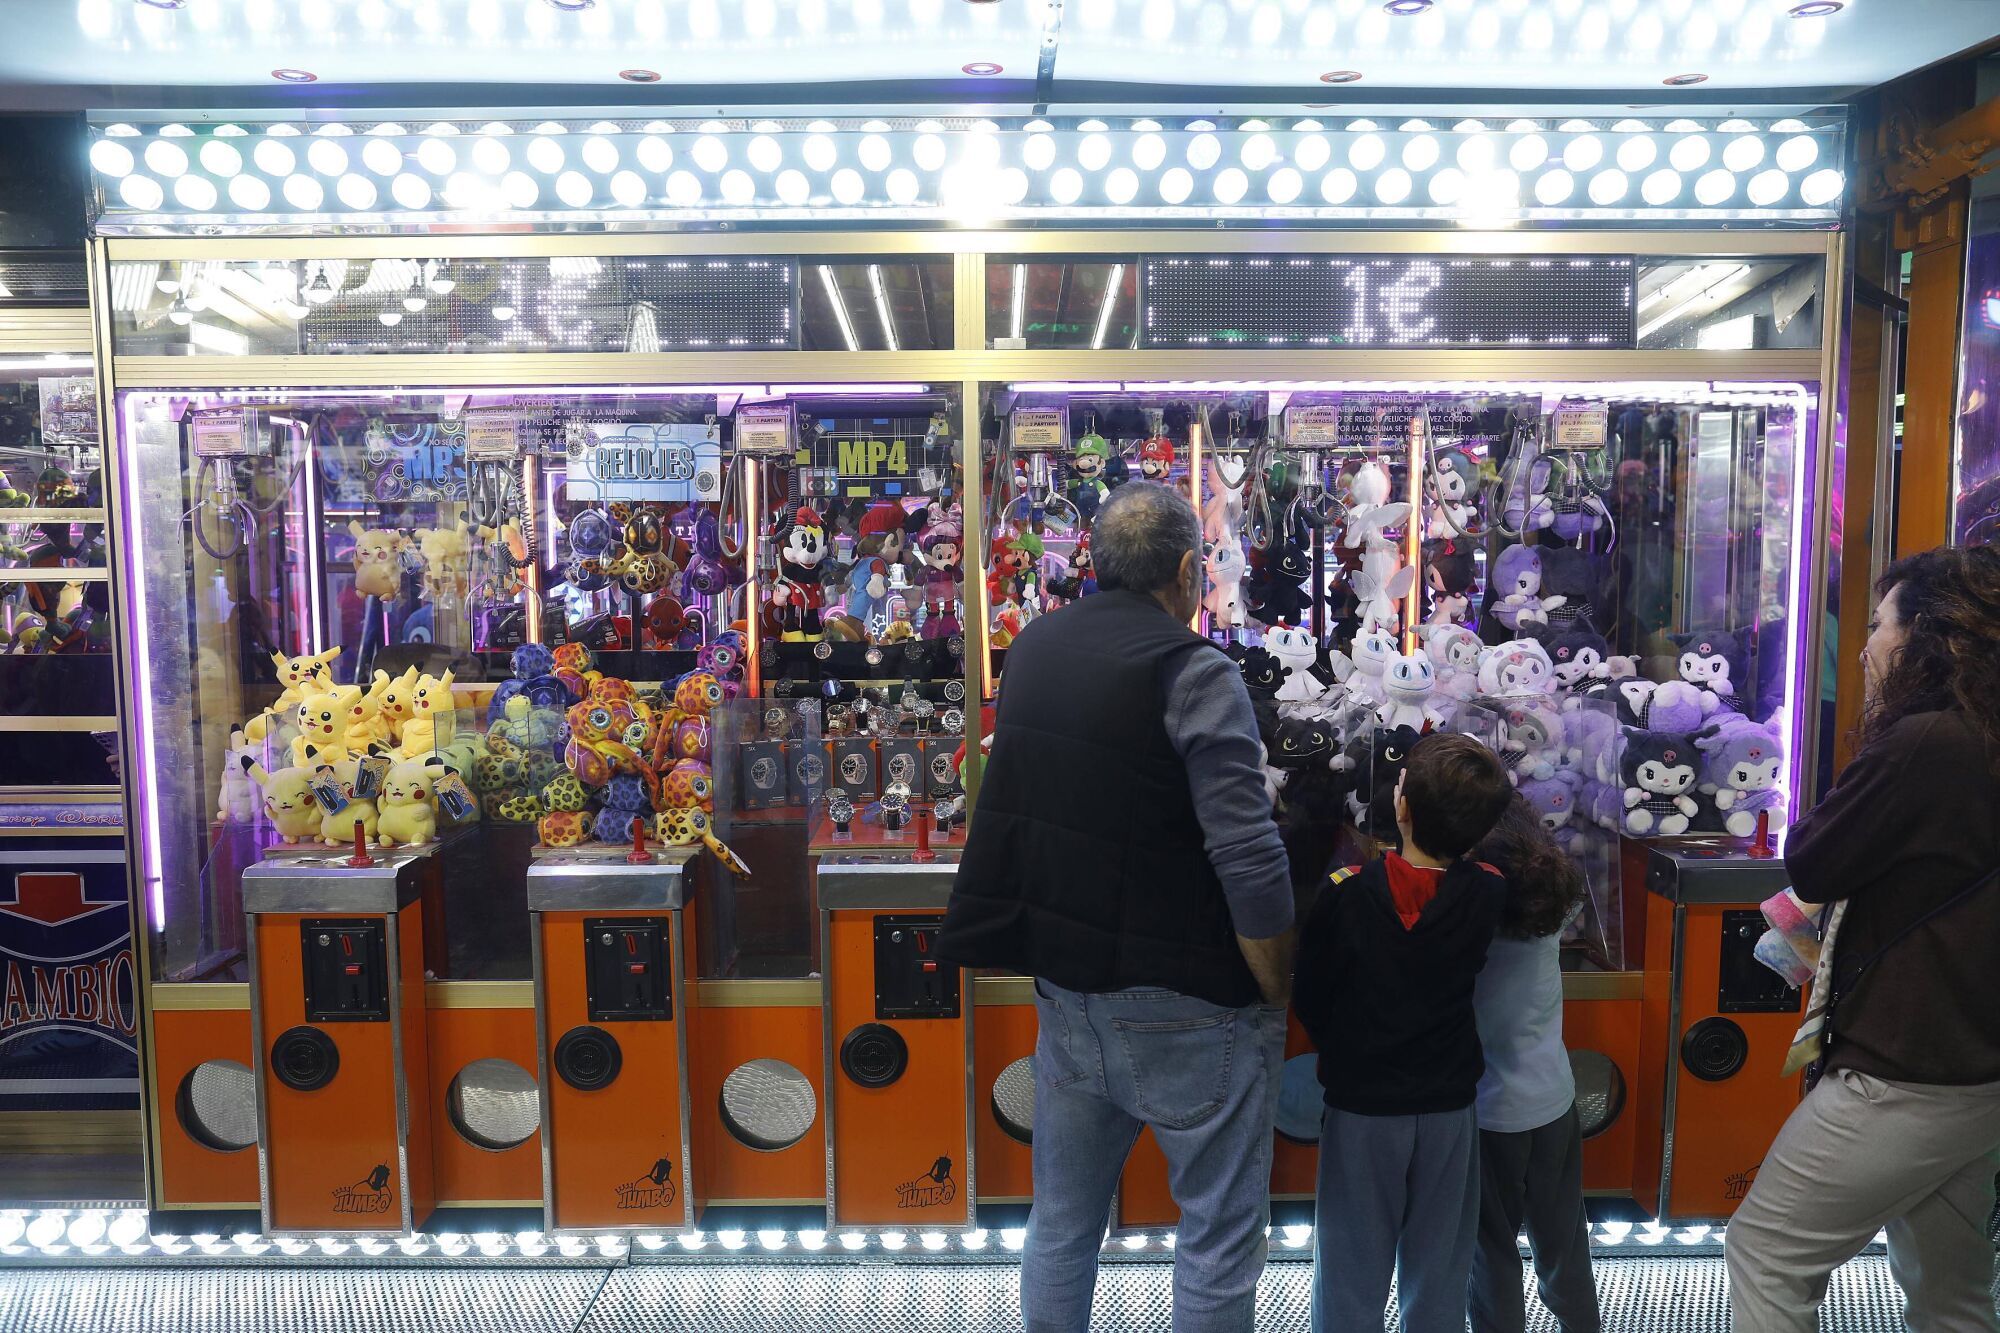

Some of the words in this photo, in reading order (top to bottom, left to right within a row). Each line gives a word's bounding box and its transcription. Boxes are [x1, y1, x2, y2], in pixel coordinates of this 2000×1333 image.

[1344, 262, 1440, 339] 1€
[530, 409, 551, 417] ANTES
[552, 409, 562, 417] DE
[563, 409, 585, 417] JUGAR
[595, 409, 604, 417] LA
[532, 418, 561, 426] PELUCHE
[592, 418, 622, 426] COGIDO
[1344, 415, 1353, 423] DE
[1384, 415, 1412, 423] PELUCHE
[1430, 415, 1441, 423] VEZ
[543, 428, 552, 436] SE
[595, 447, 696, 480] RELOJES
[838, 440, 909, 475] MP4
[0, 950, 137, 1037] AMBIO
[333, 1194, 392, 1213] JUMBO
[617, 1188, 675, 1209] JUMBO
[898, 1185, 955, 1208] JUMBO
